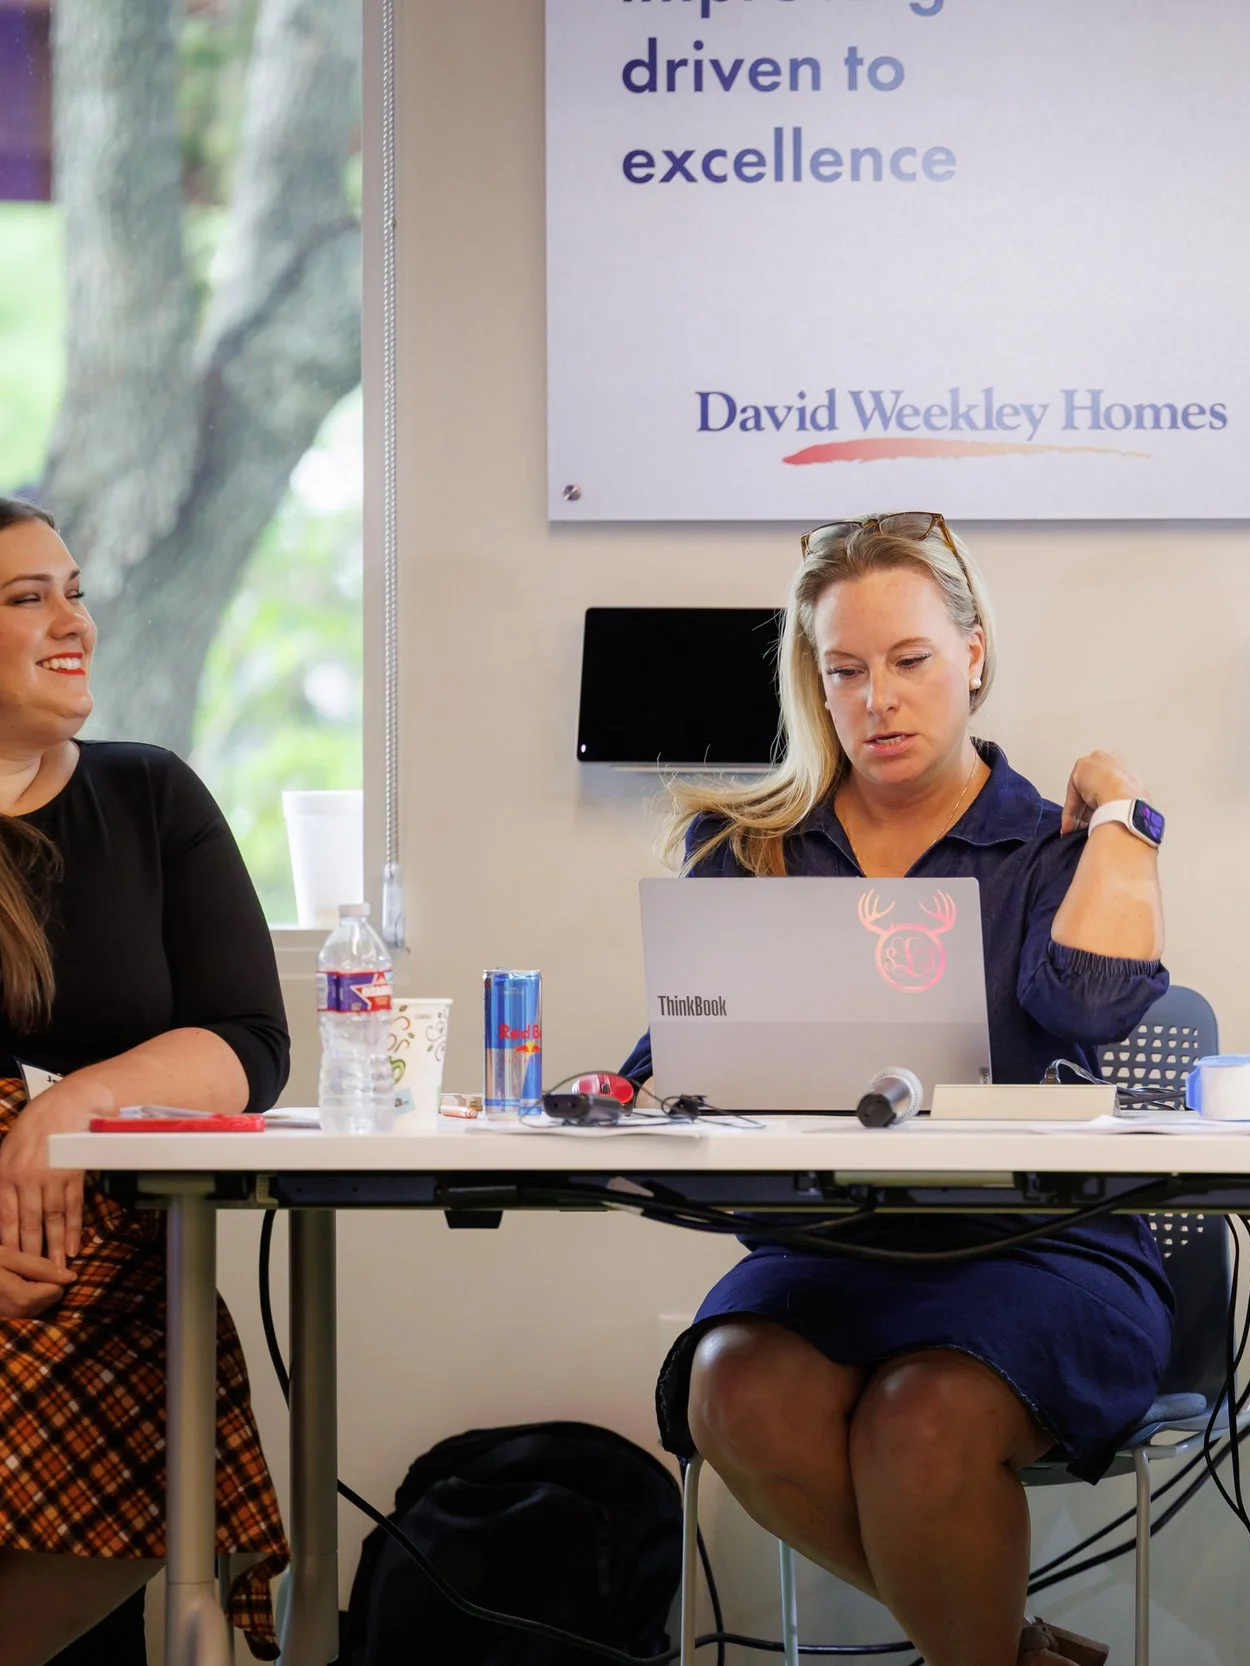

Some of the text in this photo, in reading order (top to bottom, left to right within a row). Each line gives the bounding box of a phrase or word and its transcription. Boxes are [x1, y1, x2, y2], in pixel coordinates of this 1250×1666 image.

[622, 37, 905, 93] driven to
[622, 126, 956, 184] excellence
[695, 387, 1229, 442] David Weekley Homes
[499, 1023, 531, 1040] Red
[657, 995, 728, 1017] ThinkBook
